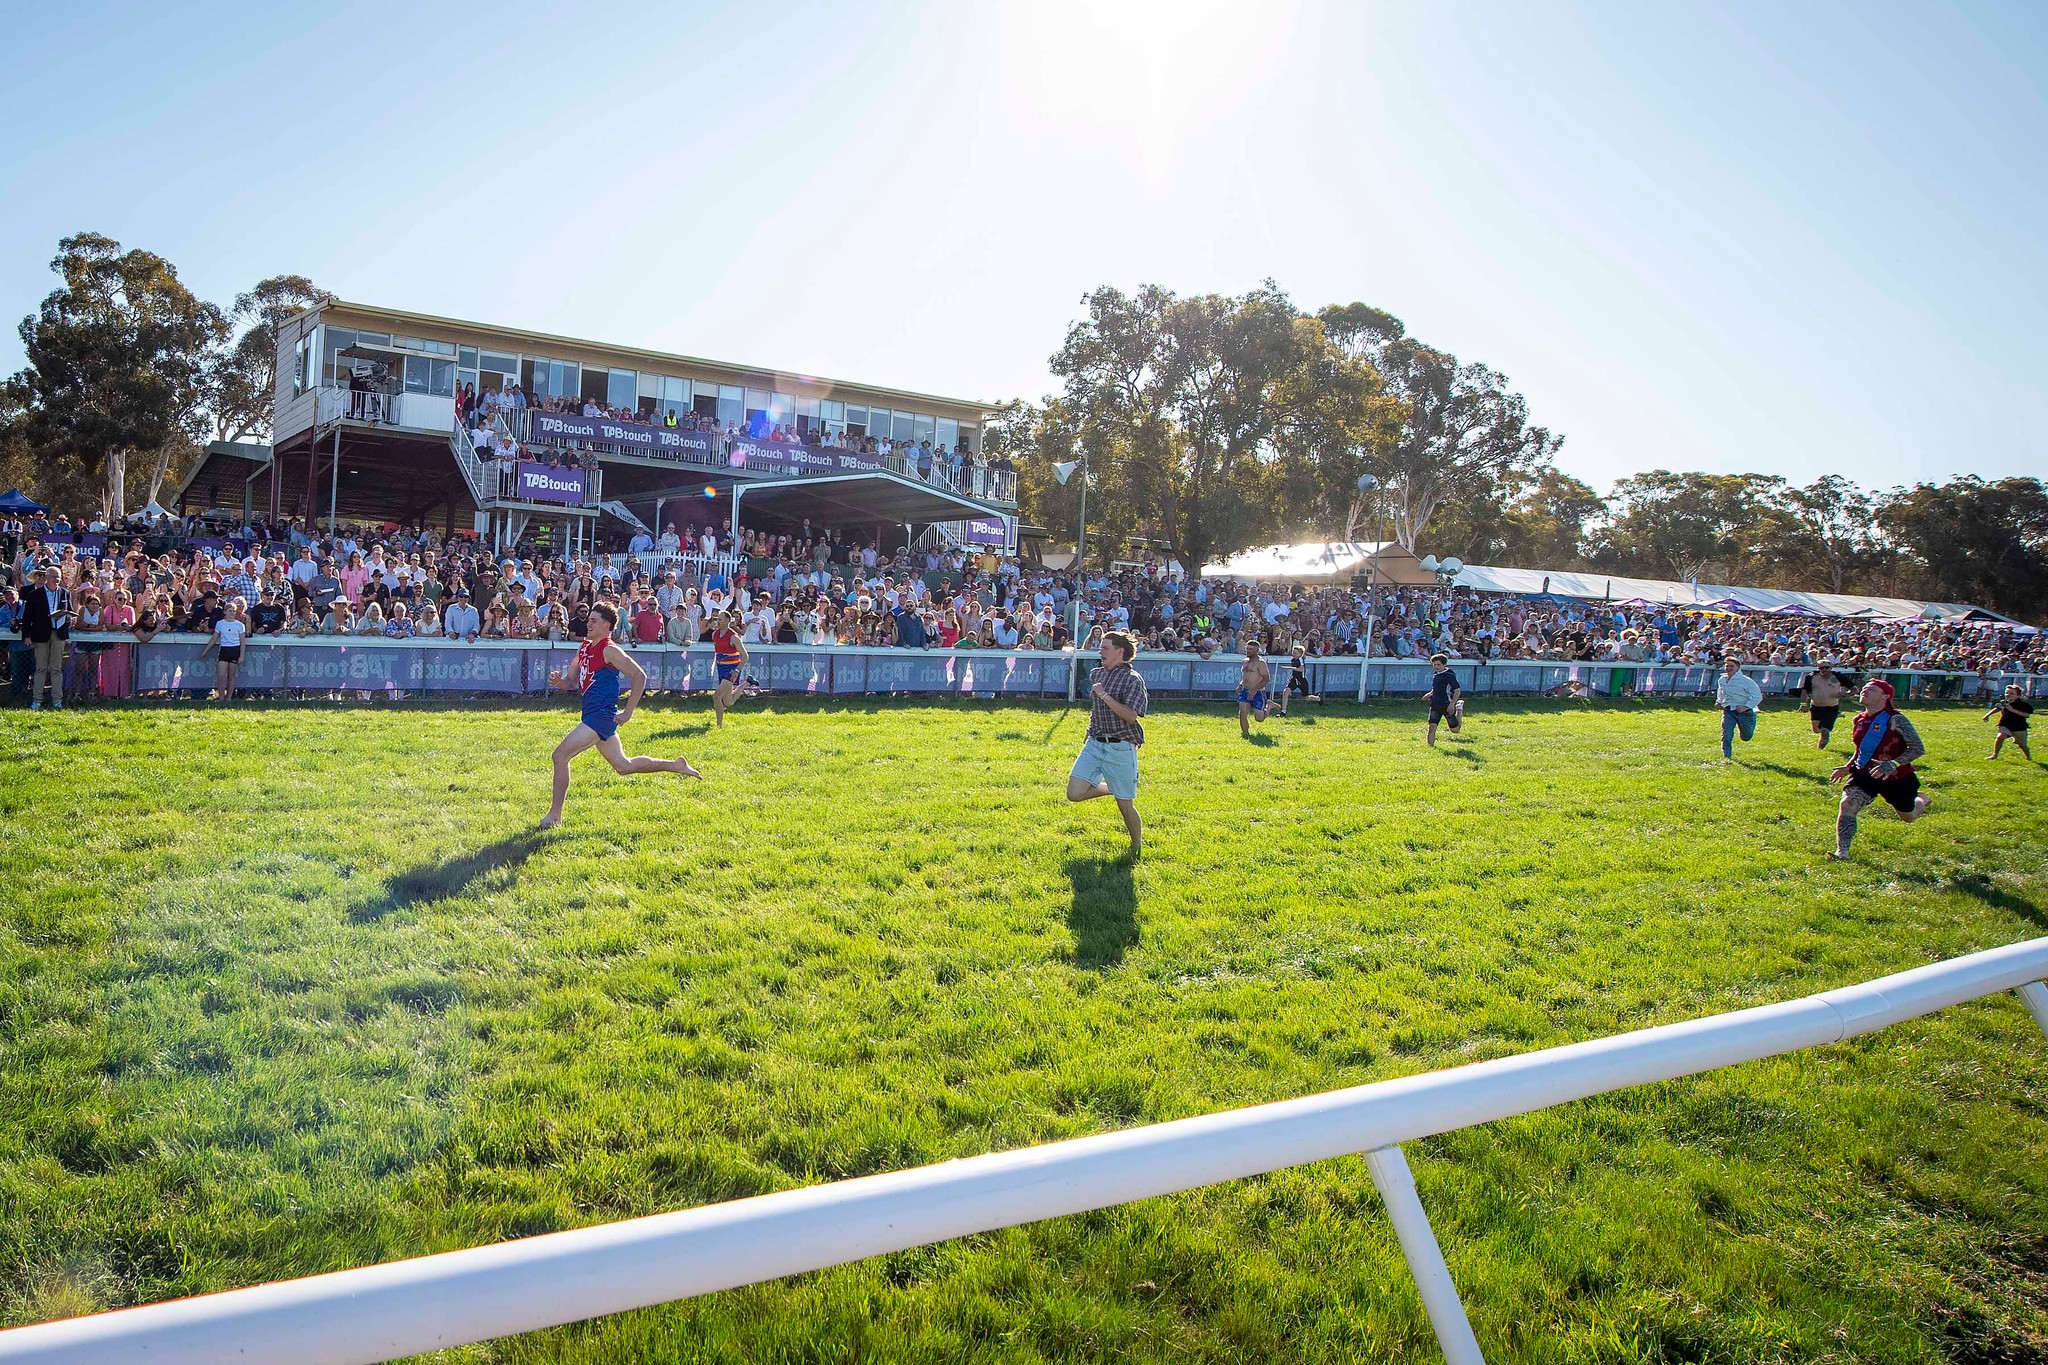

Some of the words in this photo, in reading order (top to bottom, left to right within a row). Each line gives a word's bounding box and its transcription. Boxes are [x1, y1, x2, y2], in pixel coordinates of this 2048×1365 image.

[540, 417, 594, 436] TABtouch
[601, 425, 652, 443] TABtouch
[659, 431, 707, 450] TABtouch
[736, 442, 783, 460] TABtouch
[788, 449, 833, 466] TABtouch
[523, 472, 581, 493] TABtouch
[970, 521, 1005, 536] TABtouc
